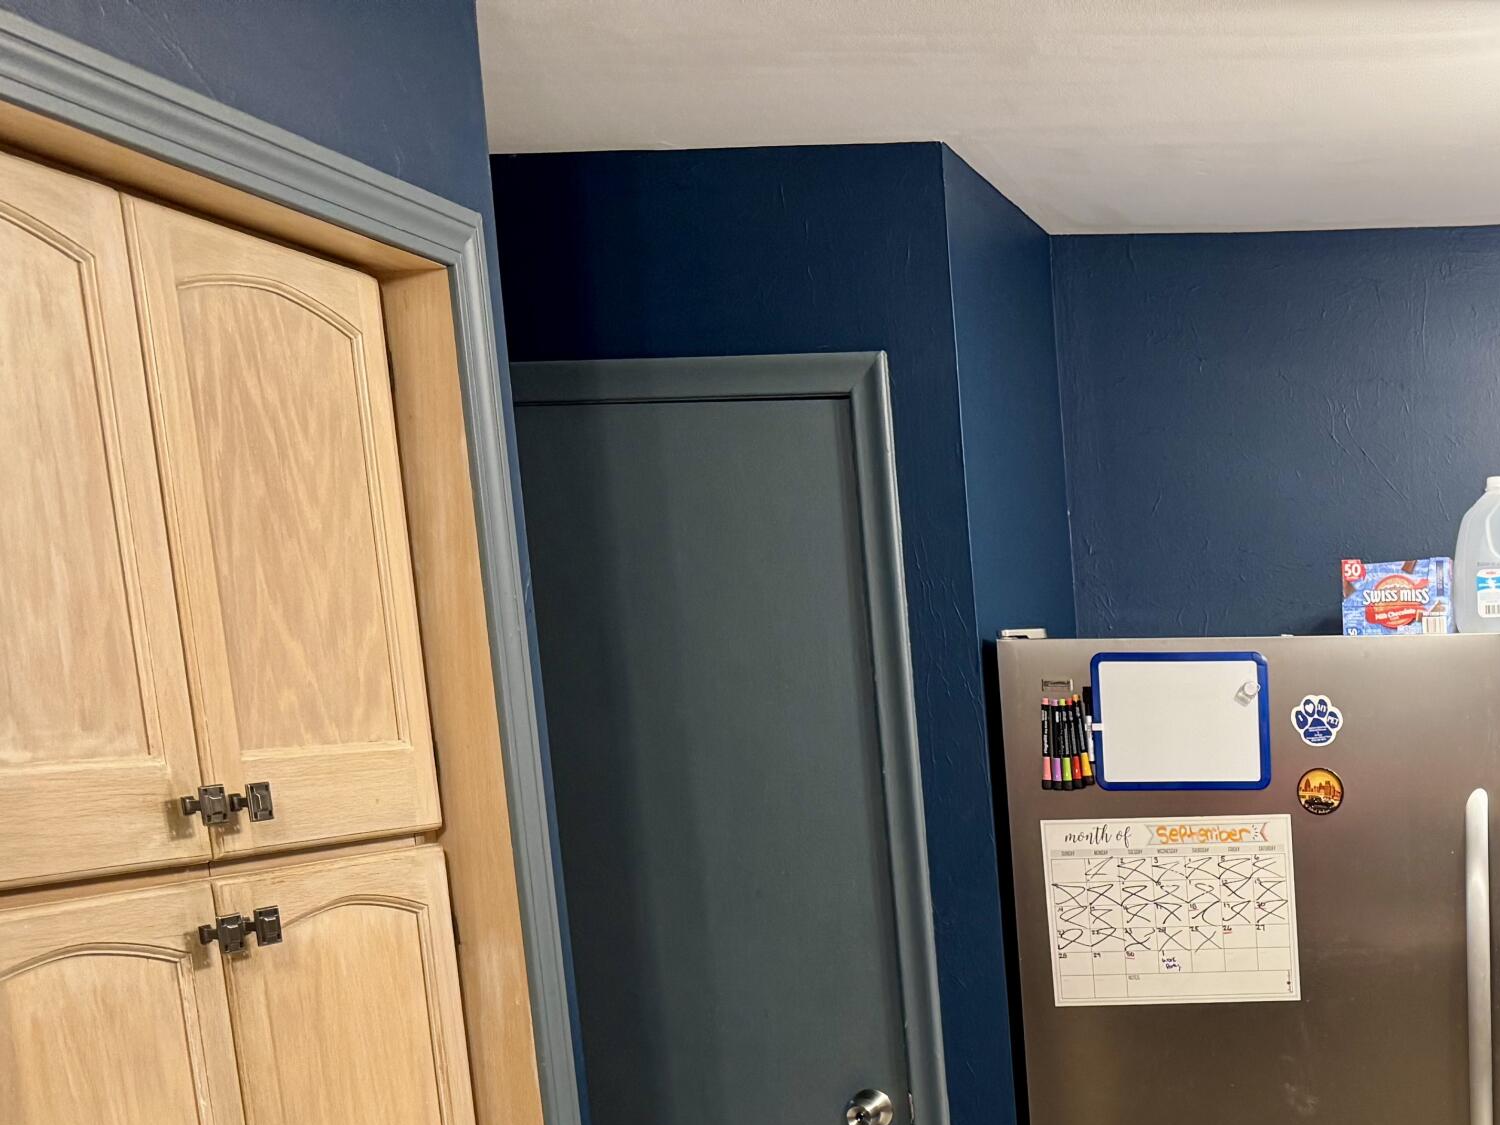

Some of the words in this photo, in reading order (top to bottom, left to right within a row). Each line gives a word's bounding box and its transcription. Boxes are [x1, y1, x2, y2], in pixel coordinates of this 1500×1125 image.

[1344, 563, 1361, 577] 50
[1363, 589, 1398, 605] SWISS
[1400, 588, 1430, 604] MISS
[1064, 823, 1113, 844] month
[1115, 826, 1134, 849] of
